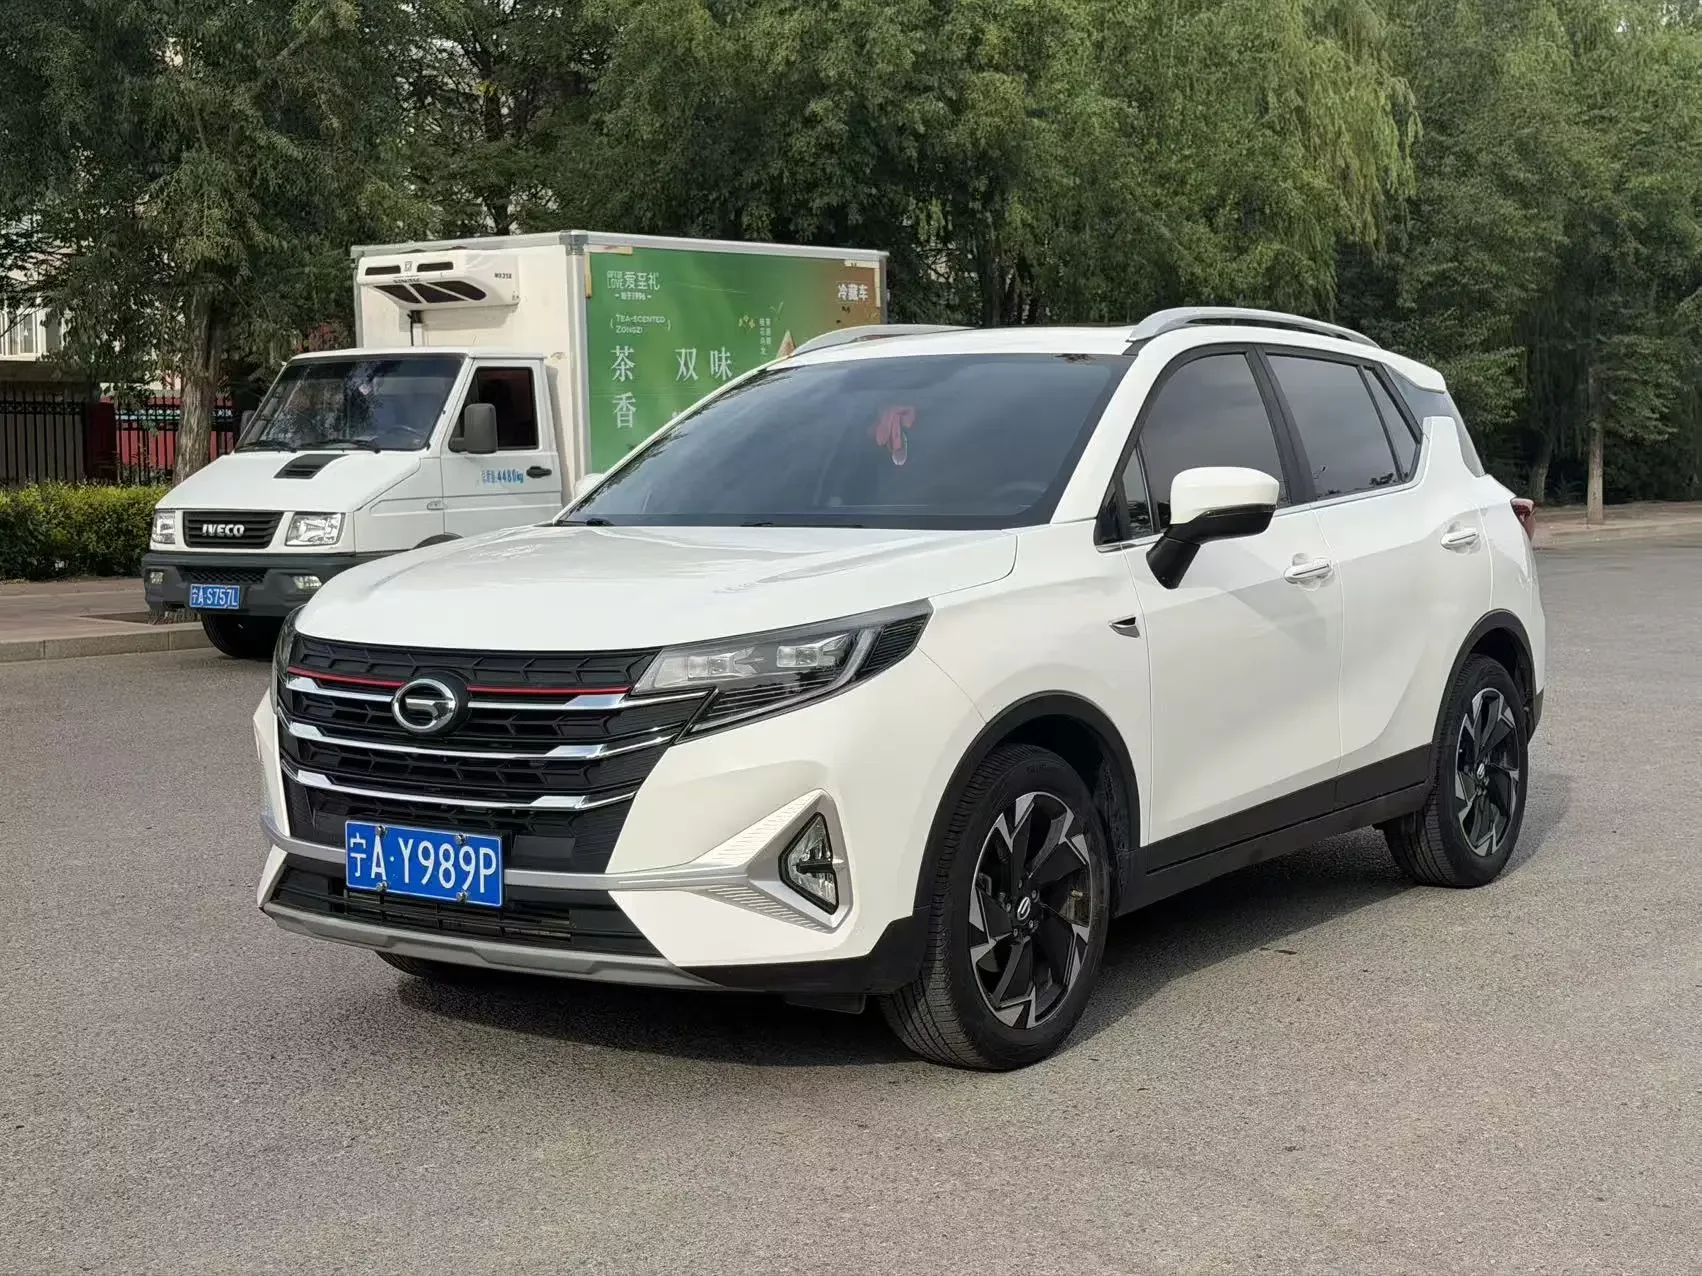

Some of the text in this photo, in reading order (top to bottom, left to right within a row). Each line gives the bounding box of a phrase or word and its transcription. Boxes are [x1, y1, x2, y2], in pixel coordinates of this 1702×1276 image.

[837, 283, 868, 301] 冷藏车
[202, 523, 245, 537] IVECO
